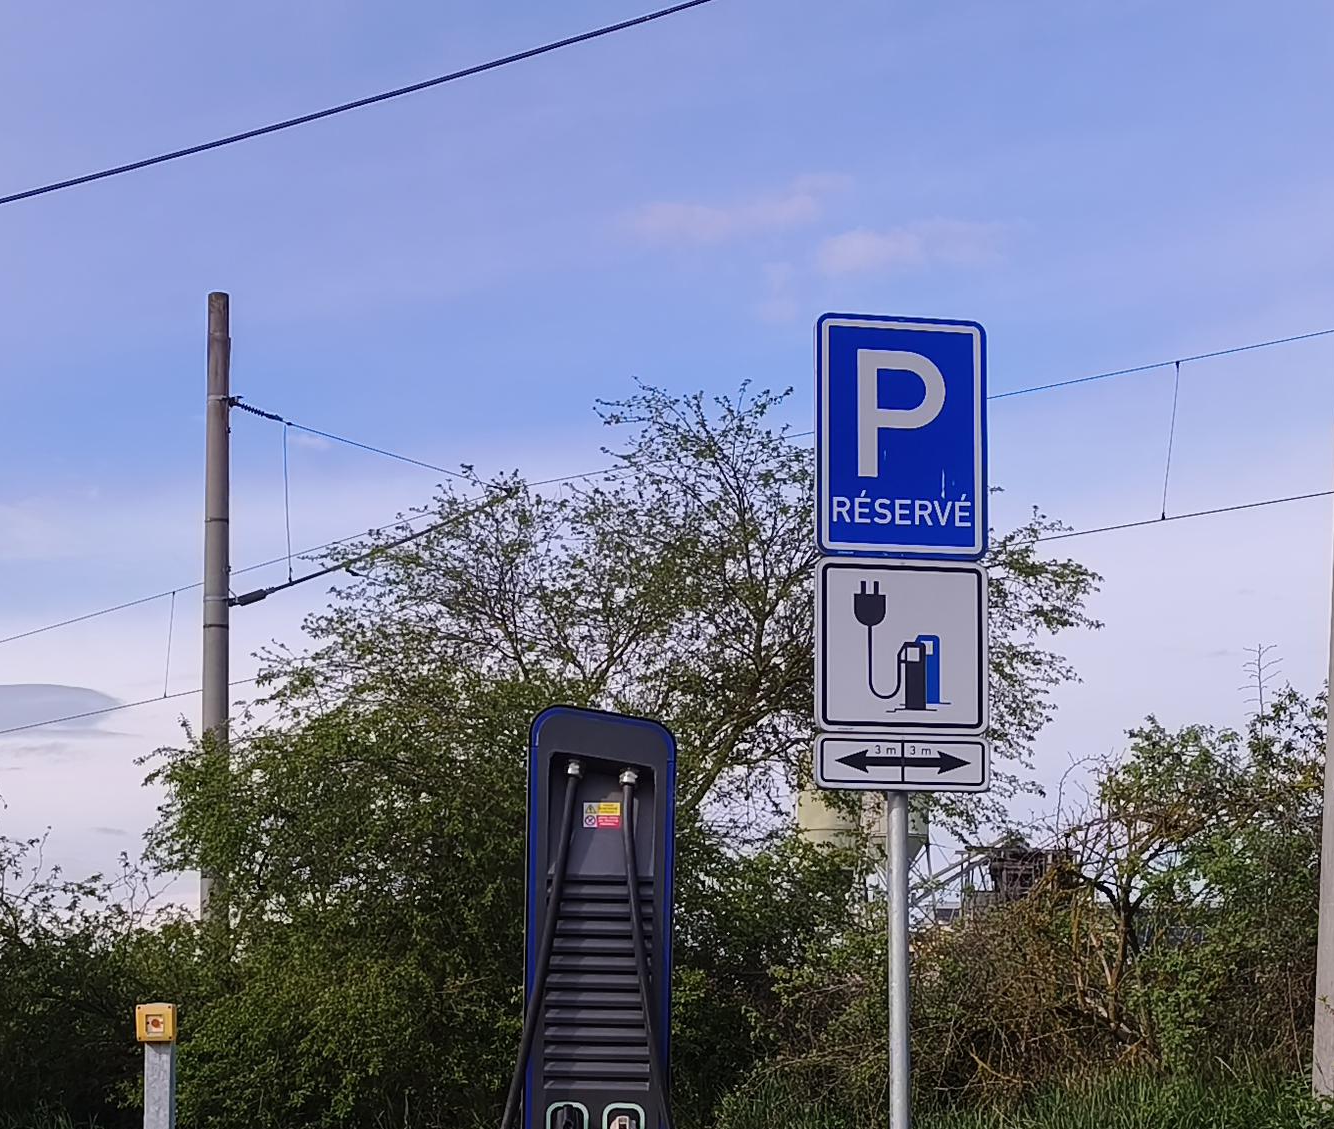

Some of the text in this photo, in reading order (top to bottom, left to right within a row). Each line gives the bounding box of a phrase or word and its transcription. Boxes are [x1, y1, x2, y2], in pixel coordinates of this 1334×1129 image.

[857, 348, 946, 478] P
[832, 489, 972, 527] RÉSERVÉ
[875, 745, 896, 755] 3 m
[910, 746, 916, 756] 3
